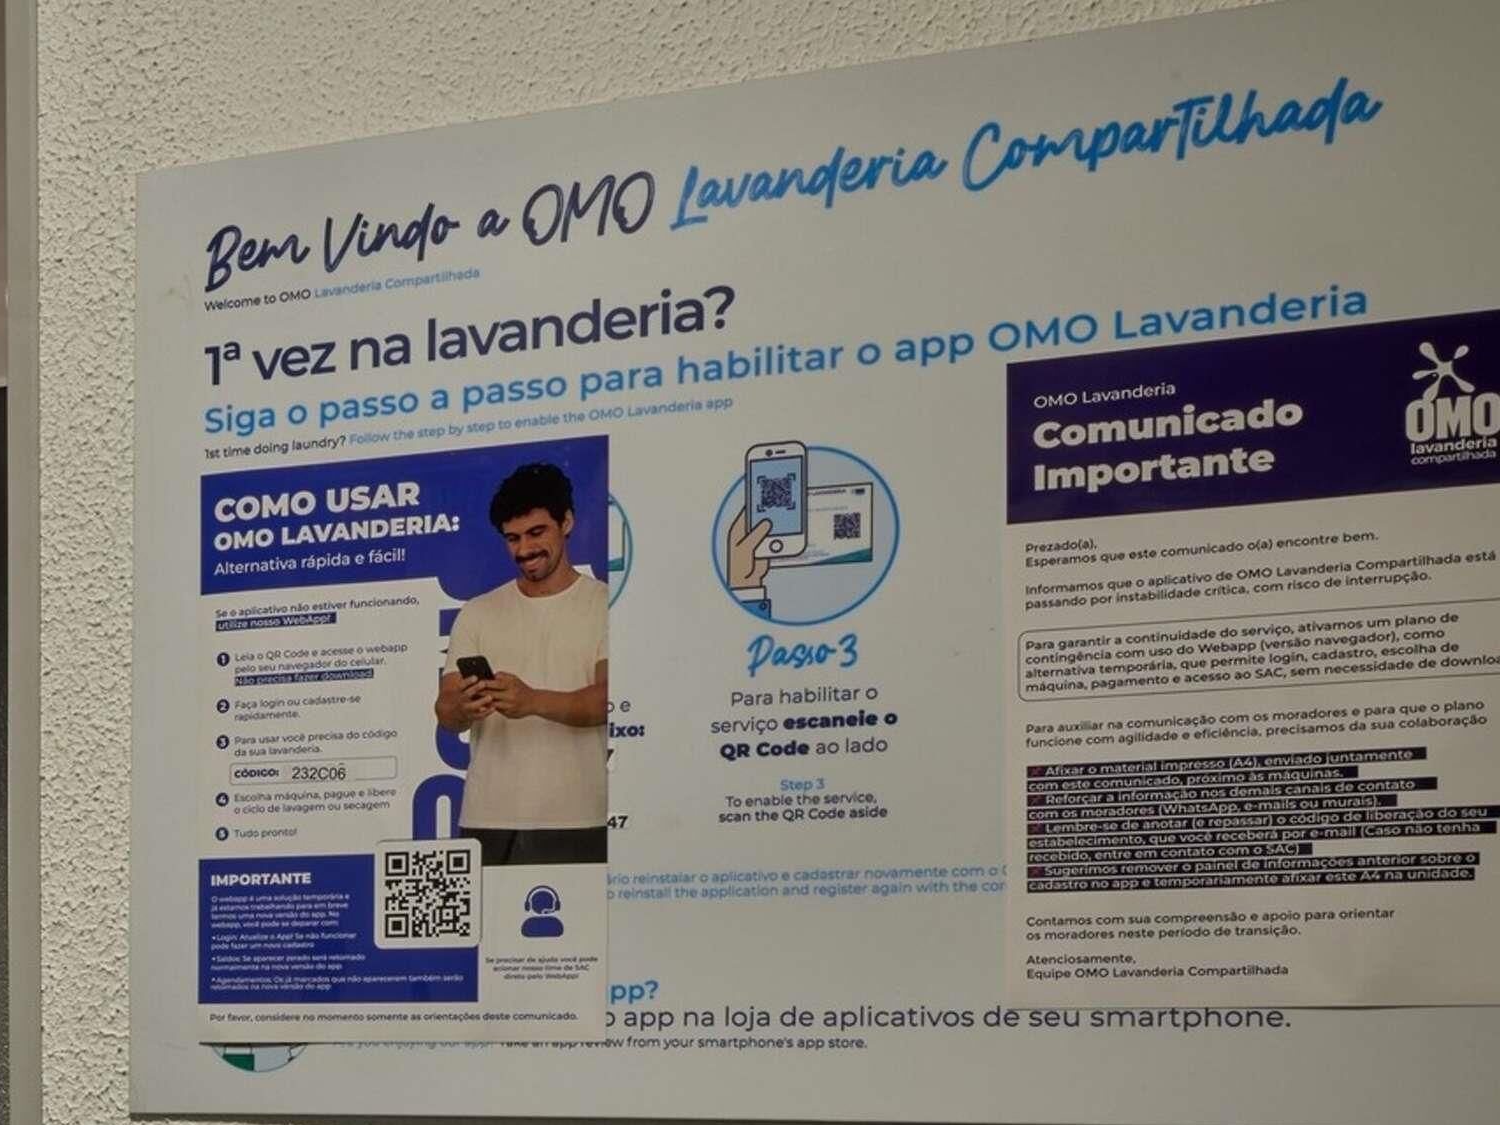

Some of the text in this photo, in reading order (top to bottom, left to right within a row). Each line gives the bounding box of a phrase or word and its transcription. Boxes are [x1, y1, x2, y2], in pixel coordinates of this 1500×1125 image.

[204, 224, 311, 293] Bem
[324, 202, 460, 273] Vindo
[477, 210, 510, 238] a
[522, 170, 656, 247] OMO
[670, 142, 949, 232] Lavanderia
[204, 285, 735, 386] 1ª vez na lavanderia?
[205, 286, 1367, 438] Siga o passo a passo para habilitar o app OMO Lavanderia
[1033, 382, 1176, 409] OMO Lavanderia
[1033, 398, 1303, 449] Comunicado
[1405, 393, 1500, 442] OMO
[1410, 436, 1497, 455] lavanderia
[1034, 447, 1275, 493] Importante
[214, 482, 420, 523] COMO USAR
[214, 513, 460, 551] OMO LAVANDERIA:
[1025, 538, 1097, 553] Prezado(a),
[214, 547, 406, 576] Alternativa rápida e fácil!
[1025, 532, 1379, 568] Esperamos que este comunicado o(a) encontre bem.
[746, 633, 858, 677] Passo 3
[731, 686, 879, 707] Para habilitar o
[711, 709, 898, 735] serviço escaneie o
[719, 737, 888, 762] QR Code ao lado
[234, 766, 347, 782] CÓDIGO: 232C06
[780, 777, 825, 794] Step 3
[725, 792, 877, 808] To enable the service,
[718, 805, 888, 823] scan the QR Code aside
[211, 872, 311, 887] IMPORTANTE
[1026, 964, 1289, 981] Equipe OMO Lavanderia Compartilhada
[623, 1005, 1019, 1032] app na loja de aplicativos de
[1029, 1006, 1291, 1032] seu smartphone.
